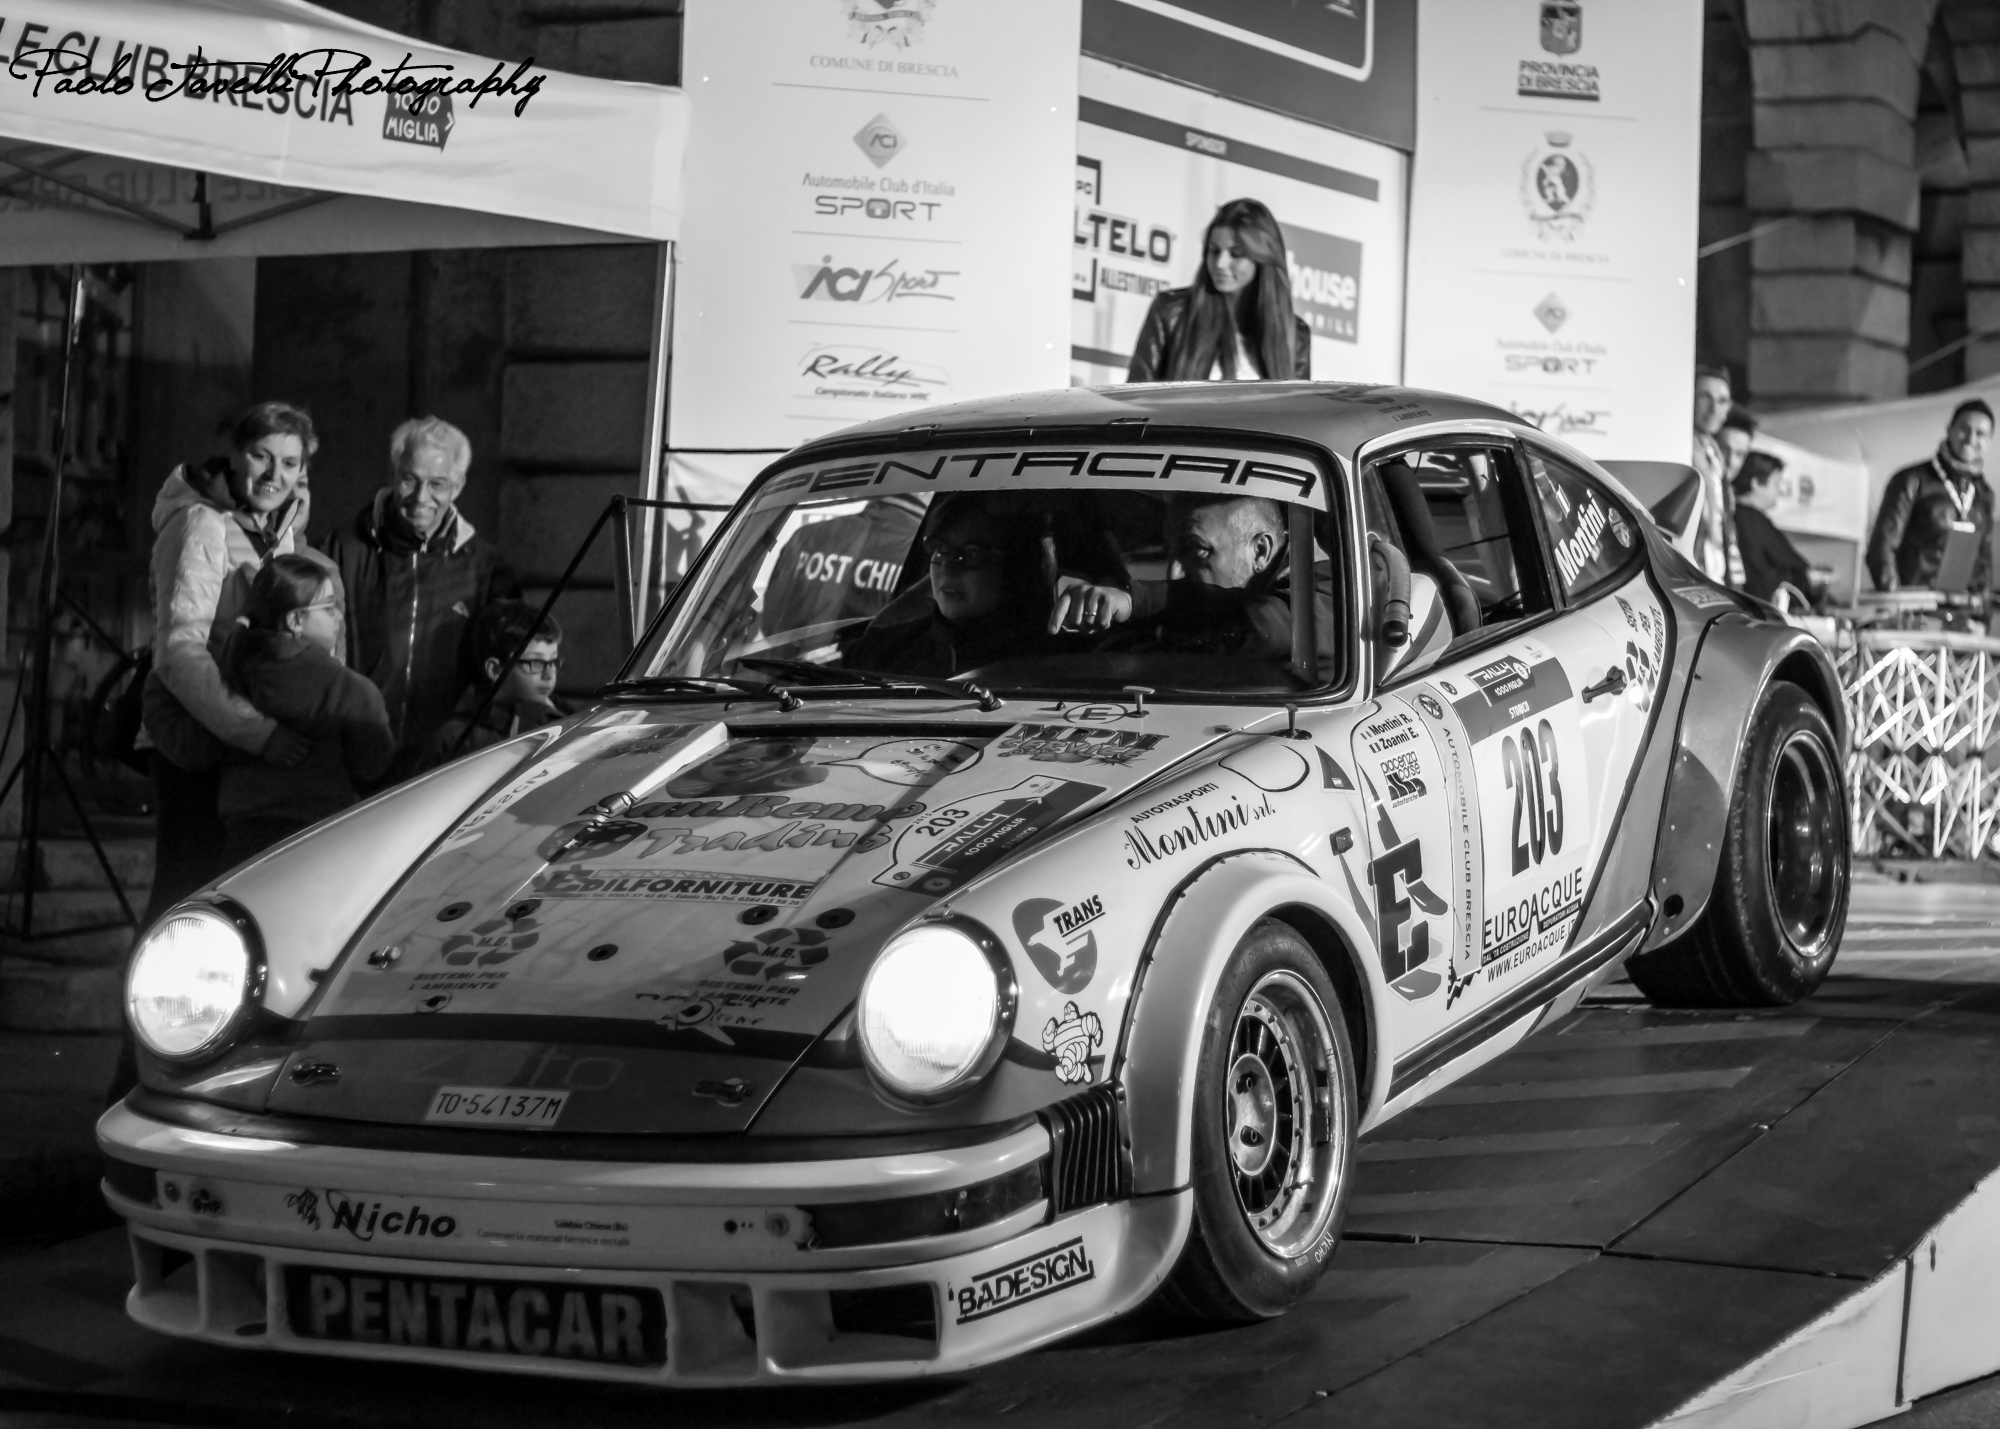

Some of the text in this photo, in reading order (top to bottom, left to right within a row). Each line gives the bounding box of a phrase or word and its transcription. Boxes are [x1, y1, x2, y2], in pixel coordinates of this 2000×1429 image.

[53, 30, 169, 92] CLUB
[183, 53, 354, 127] BRESCIA
[809, 54, 959, 79] COMUNE DI BRESCIA
[1518, 59, 1600, 80] PROVINCIA
[1518, 74, 1600, 93] DI BRESCIA
[385, 116, 440, 144] MIGLIA
[802, 171, 956, 197] Automobile Club d'Italia
[815, 195, 942, 222] SPORT
[801, 354, 912, 388] Rally
[1504, 354, 1598, 375] SPORT
[814, 386, 870, 399] Campionato
[759, 450, 1318, 499] PENTACAR
[1554, 488, 1607, 587] Montini
[794, 550, 854, 584] POST
[1483, 661, 1516, 681] RALLY
[1368, 713, 1413, 736] Montini R.
[1379, 726, 1420, 750] Zoanni E.
[1130, 782, 1220, 824] AUTOTRASPORTI
[1501, 718, 1565, 878] 203
[914, 807, 971, 837] 203
[1123, 794, 1250, 870] Montini
[1441, 726, 1473, 961] AUTOMOBILE CLUB BRESCIA
[1053, 894, 1104, 935] TRANS
[1483, 866, 1583, 950] EUROACQUE
[475, 936, 509, 948] M.B.
[760, 945, 796, 960] M.B.
[414, 971, 509, 981] SISTEMI PER
[697, 979, 801, 995] SISTEMI PER
[330, 1199, 457, 1240] Nicho
[957, 1245, 1089, 1316] BADESIGN
[308, 1273, 646, 1363] PENTACAR
